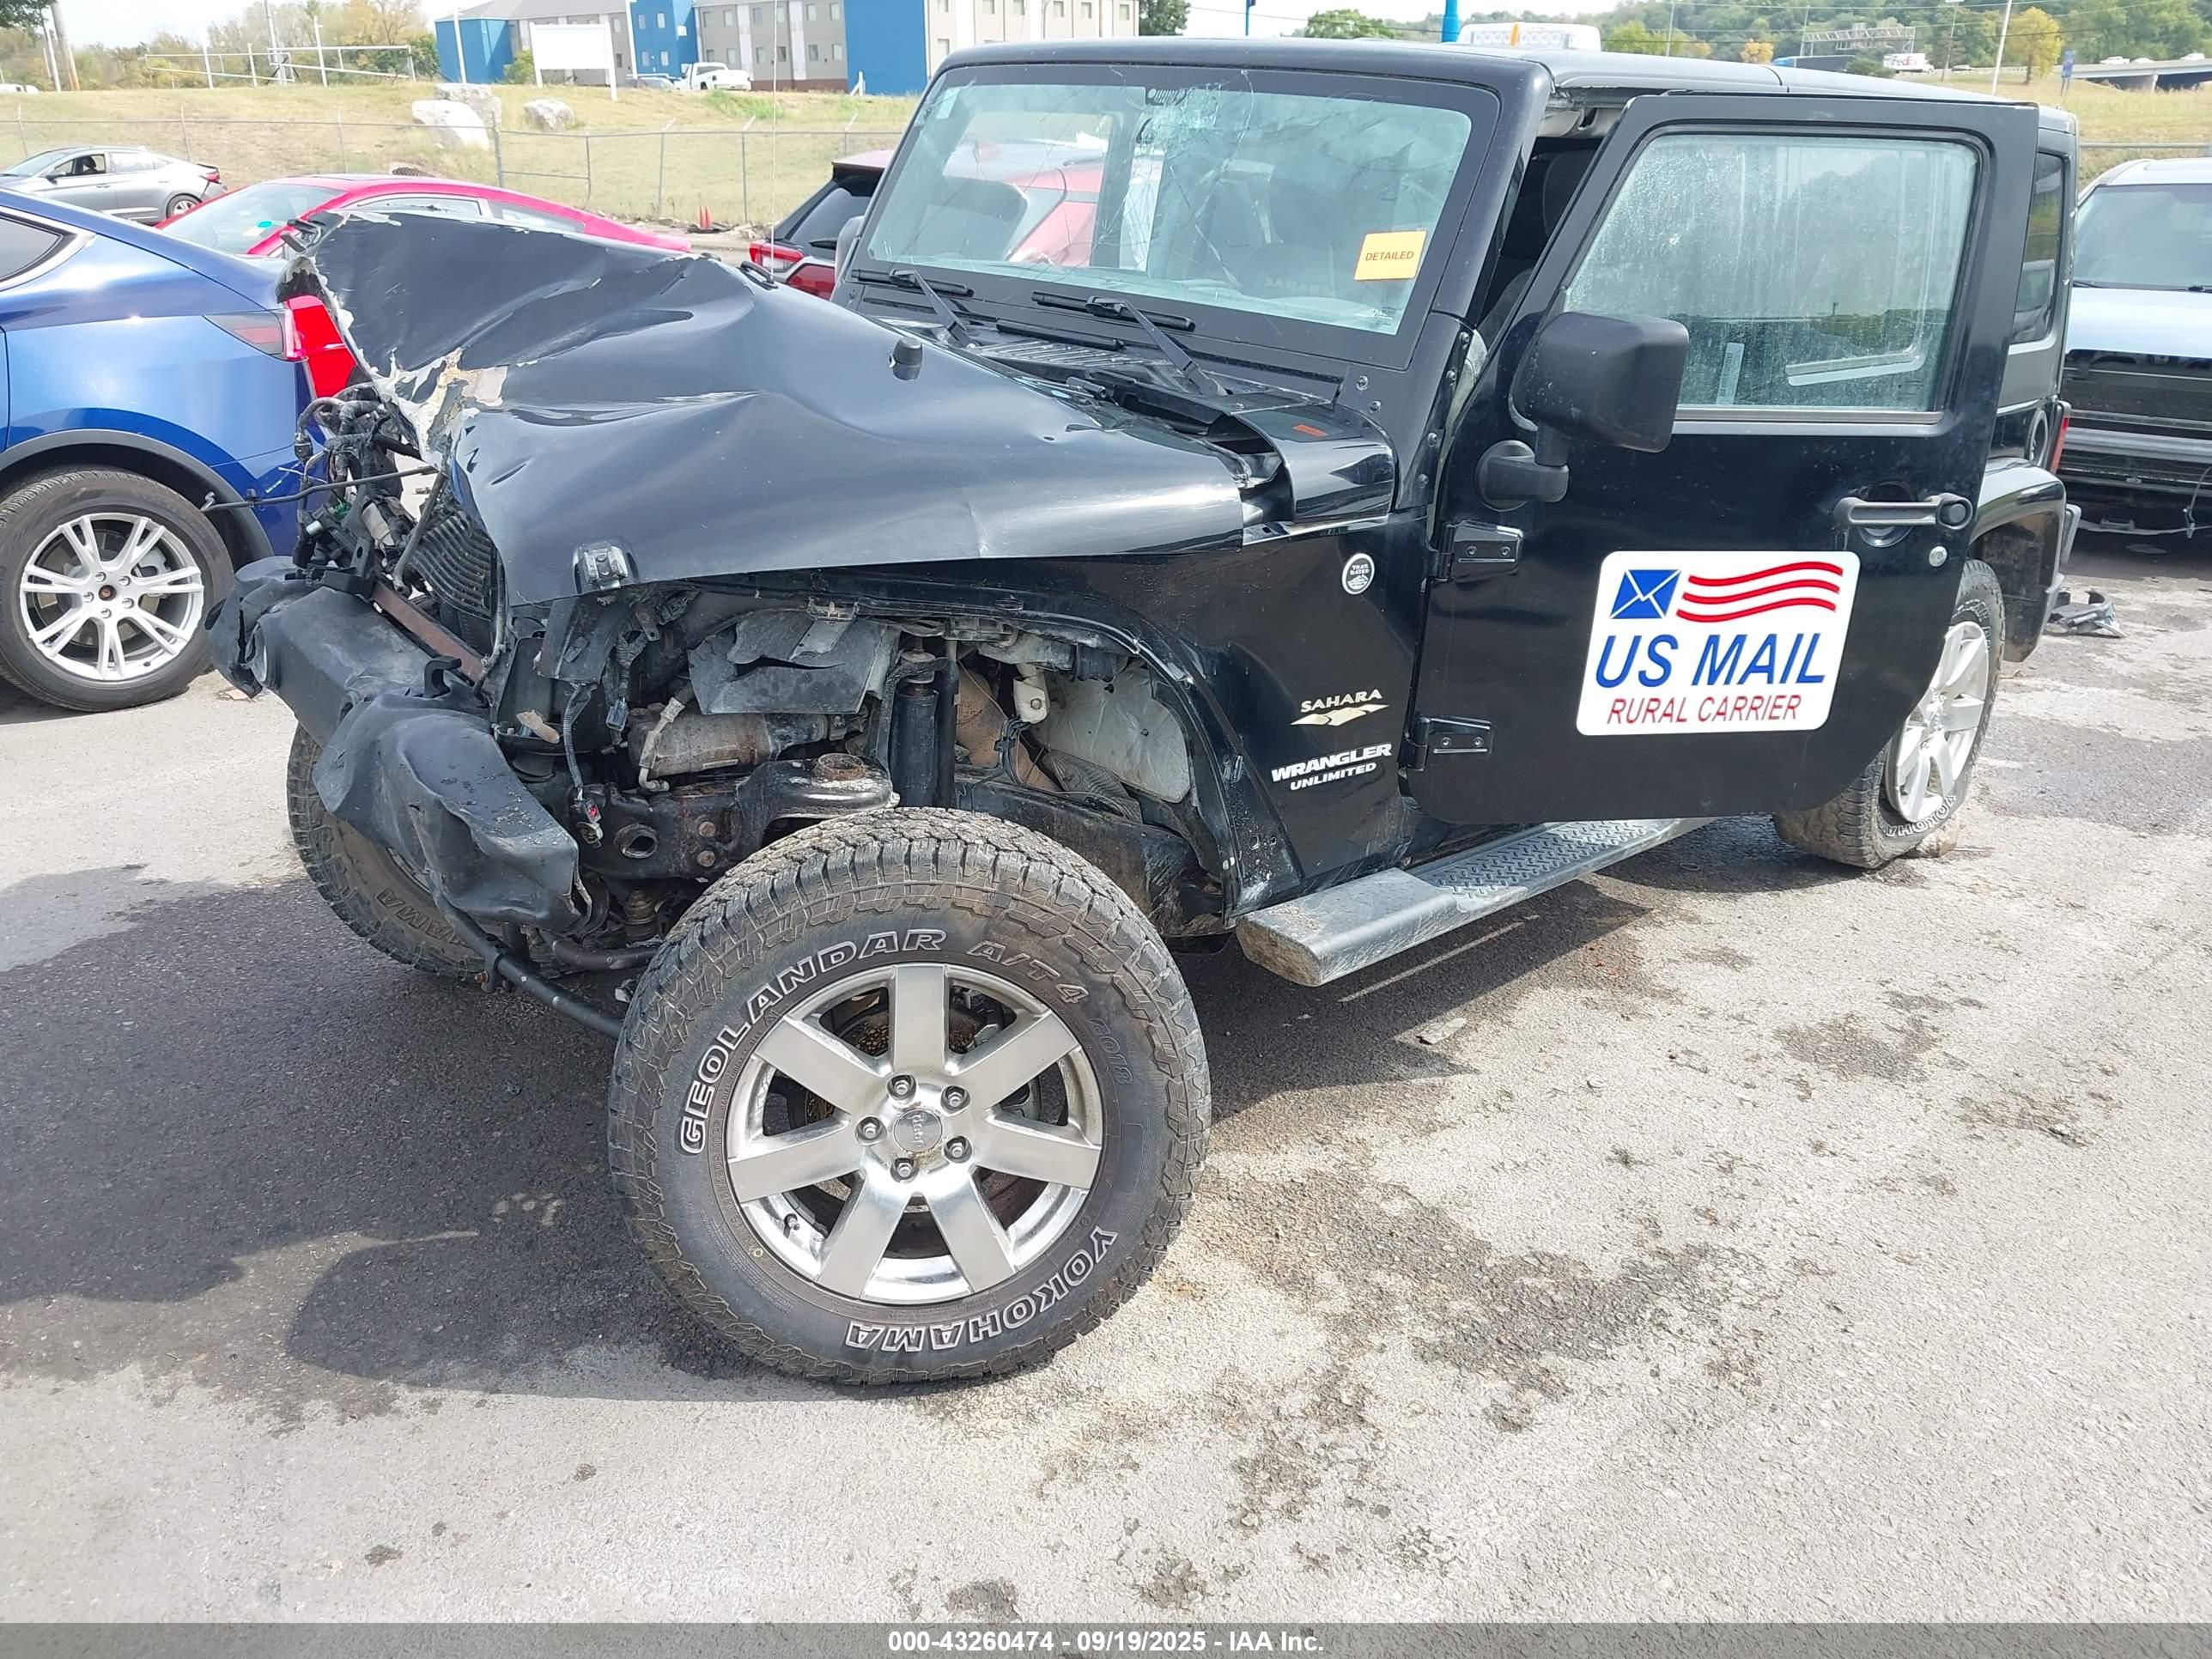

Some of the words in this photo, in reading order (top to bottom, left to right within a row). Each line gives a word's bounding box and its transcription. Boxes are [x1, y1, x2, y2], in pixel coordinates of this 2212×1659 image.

[1364, 251, 1414, 261] DETAILED
[1595, 634, 1679, 688] US
[1691, 632, 1826, 686] MAIL
[1300, 689, 1382, 713] SAHARA
[1607, 696, 1688, 724] RURAL
[1698, 694, 1802, 722] CARRIER
[1271, 743, 1392, 782] WRANGLER
[1290, 762, 1377, 791] UNLIMITED
[679, 928, 947, 1155] GEOLANDAR
[966, 939, 1061, 981] A/T
[1055, 983, 1090, 1004] 4
[845, 1224, 1118, 1352] YOKOHAMA
